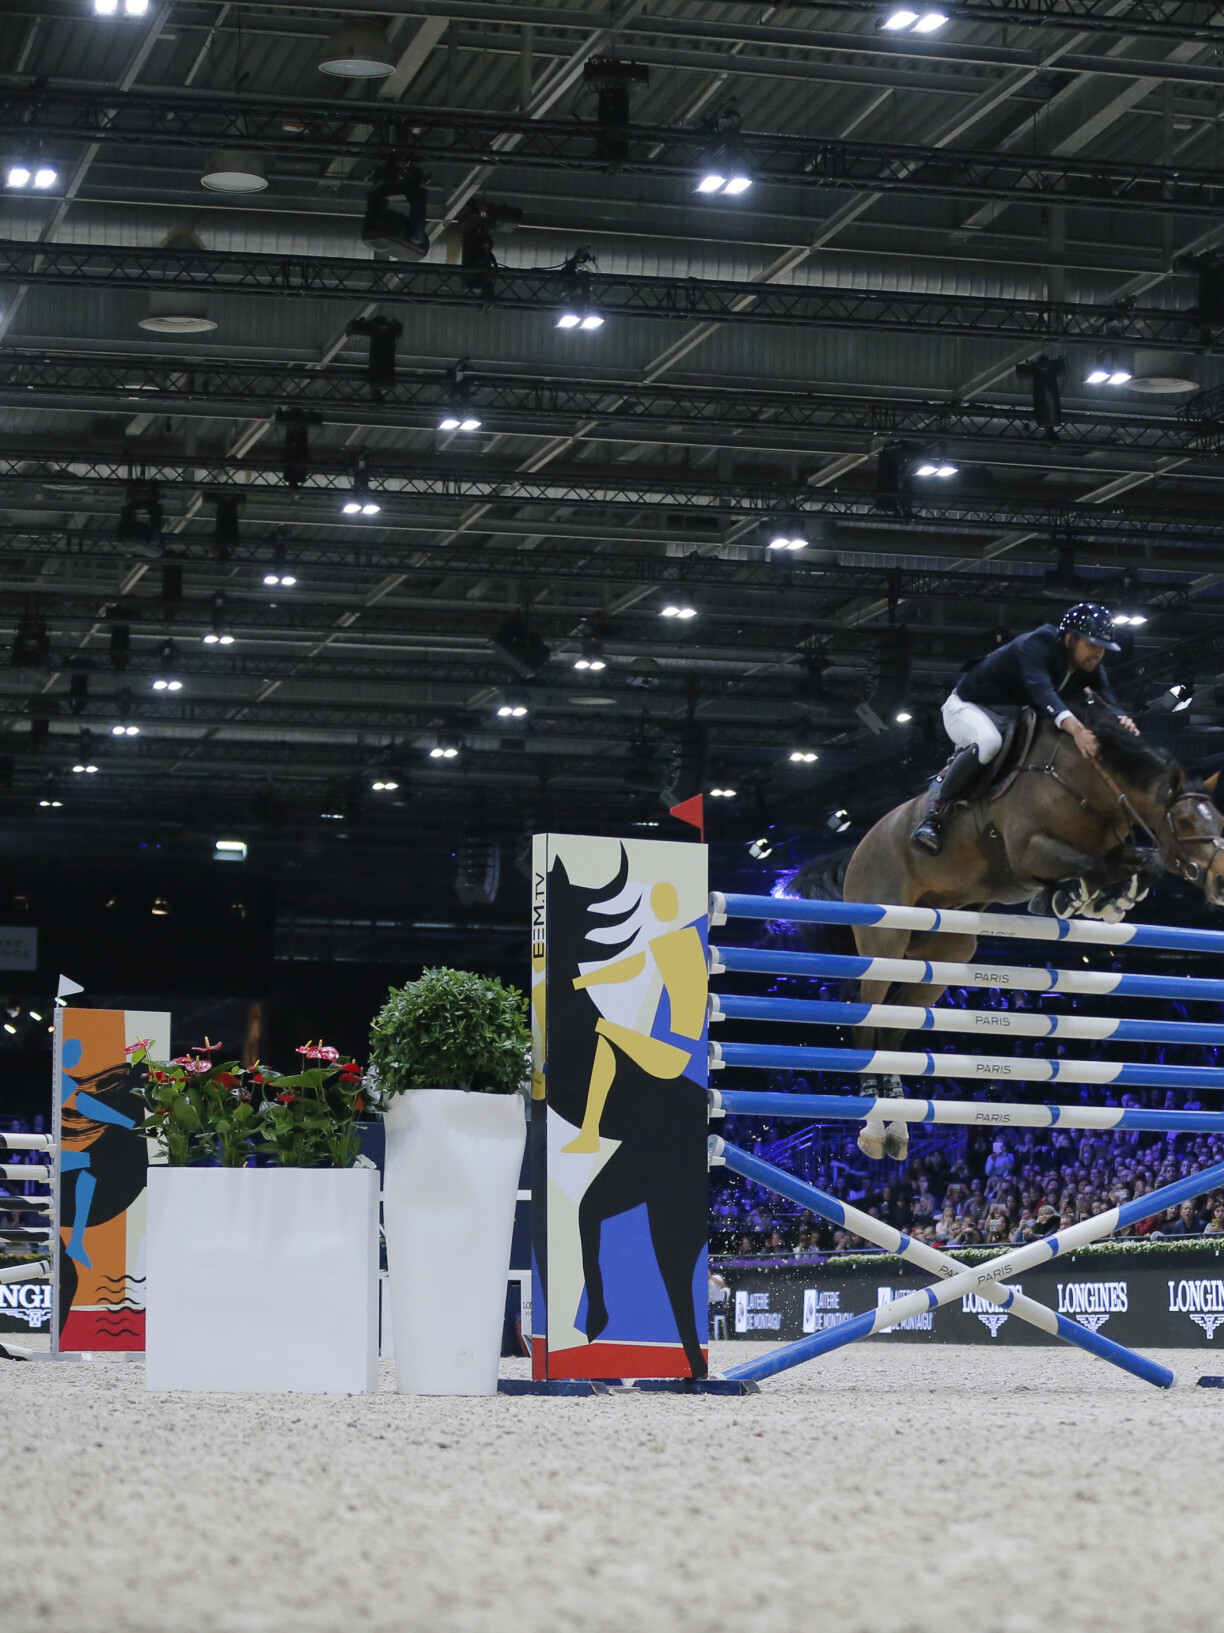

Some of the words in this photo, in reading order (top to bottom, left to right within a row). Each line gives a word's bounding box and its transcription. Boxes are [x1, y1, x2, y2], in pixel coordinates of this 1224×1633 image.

[532, 872, 545, 958] EEM.TV
[974, 972, 1010, 984] PARIS
[975, 1015, 1011, 1027] PARIS
[976, 1063, 1011, 1075] PARIS
[975, 1113, 1011, 1123] PARIS
[977, 1264, 1013, 1285] PARIS
[1057, 1282, 1128, 1313] LONGINES
